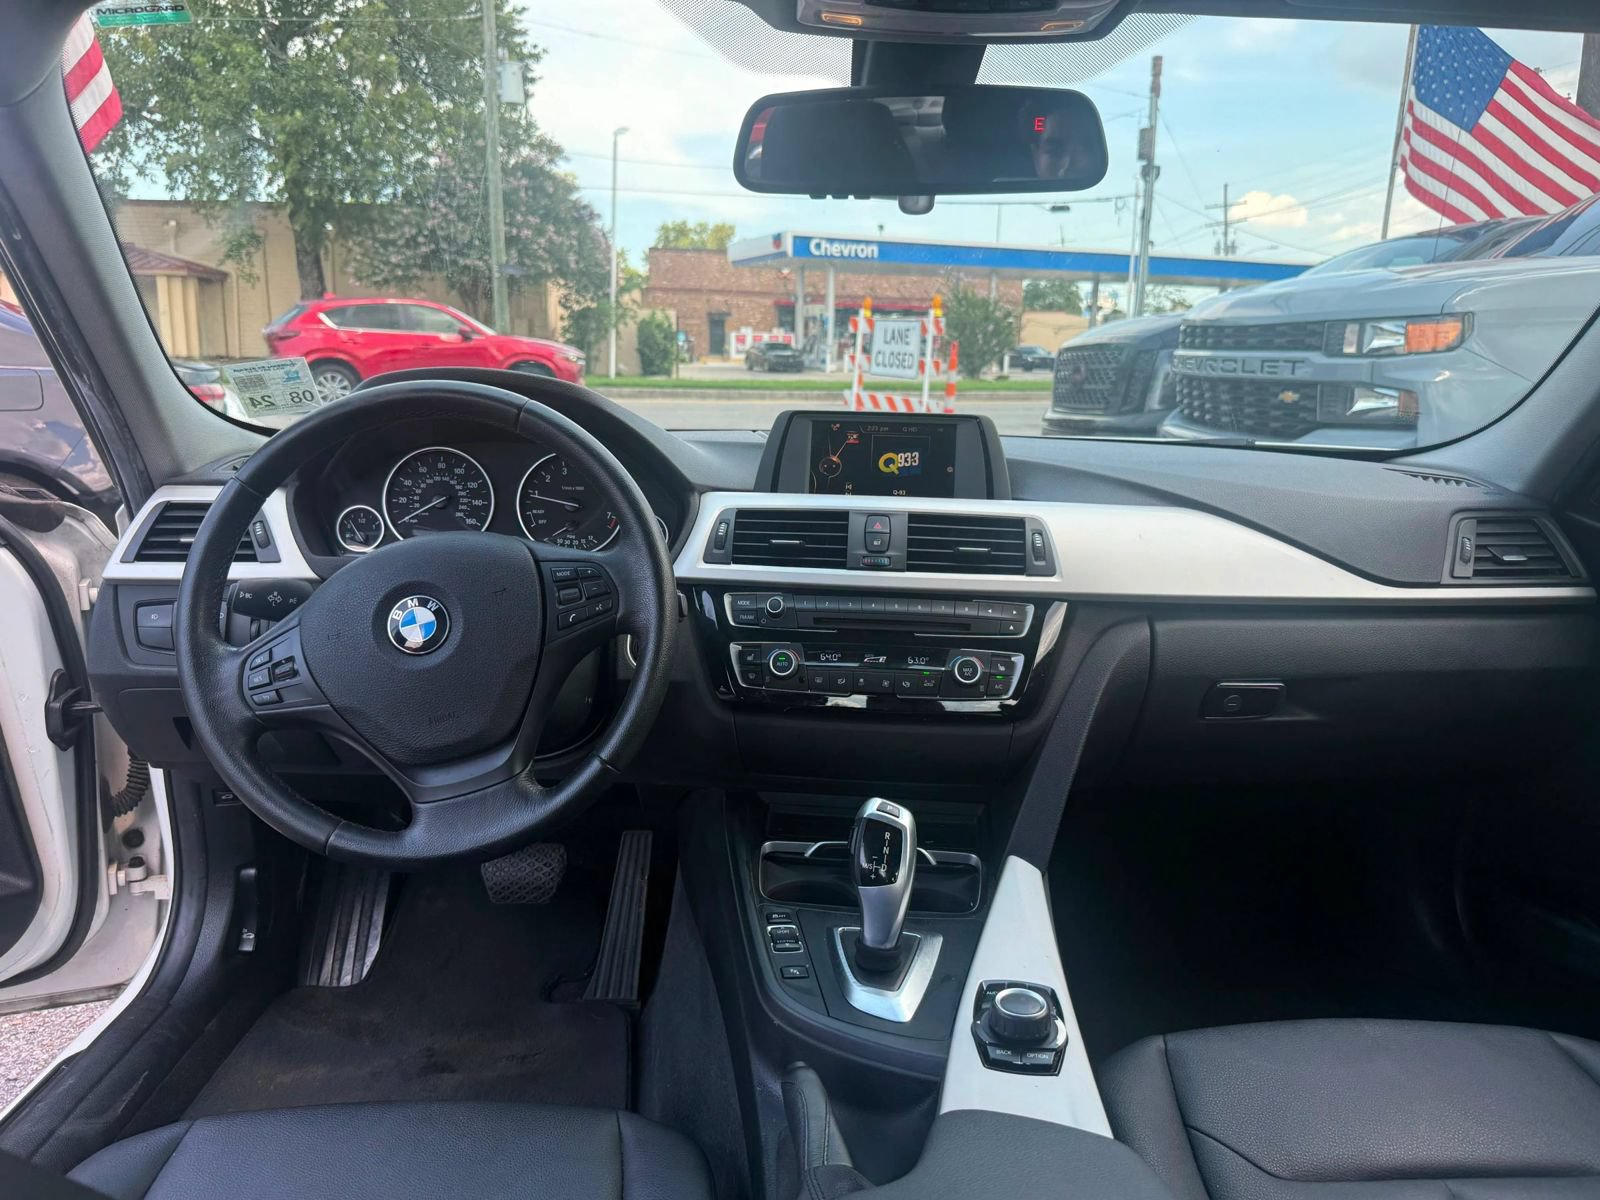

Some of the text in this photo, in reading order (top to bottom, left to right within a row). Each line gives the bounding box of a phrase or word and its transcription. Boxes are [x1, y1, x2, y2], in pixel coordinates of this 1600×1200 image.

[1034, 116, 1046, 131] E
[809, 238, 880, 259] Chevron
[883, 328, 912, 346] LANE
[874, 352, 915, 370] CLOSED
[545, 474, 551, 482] 2
[606, 511, 612, 519] 7
[392, 598, 440, 621] BMW
[884, 831, 891, 840] R
[882, 846, 890, 855] N
[880, 863, 887, 872] D
